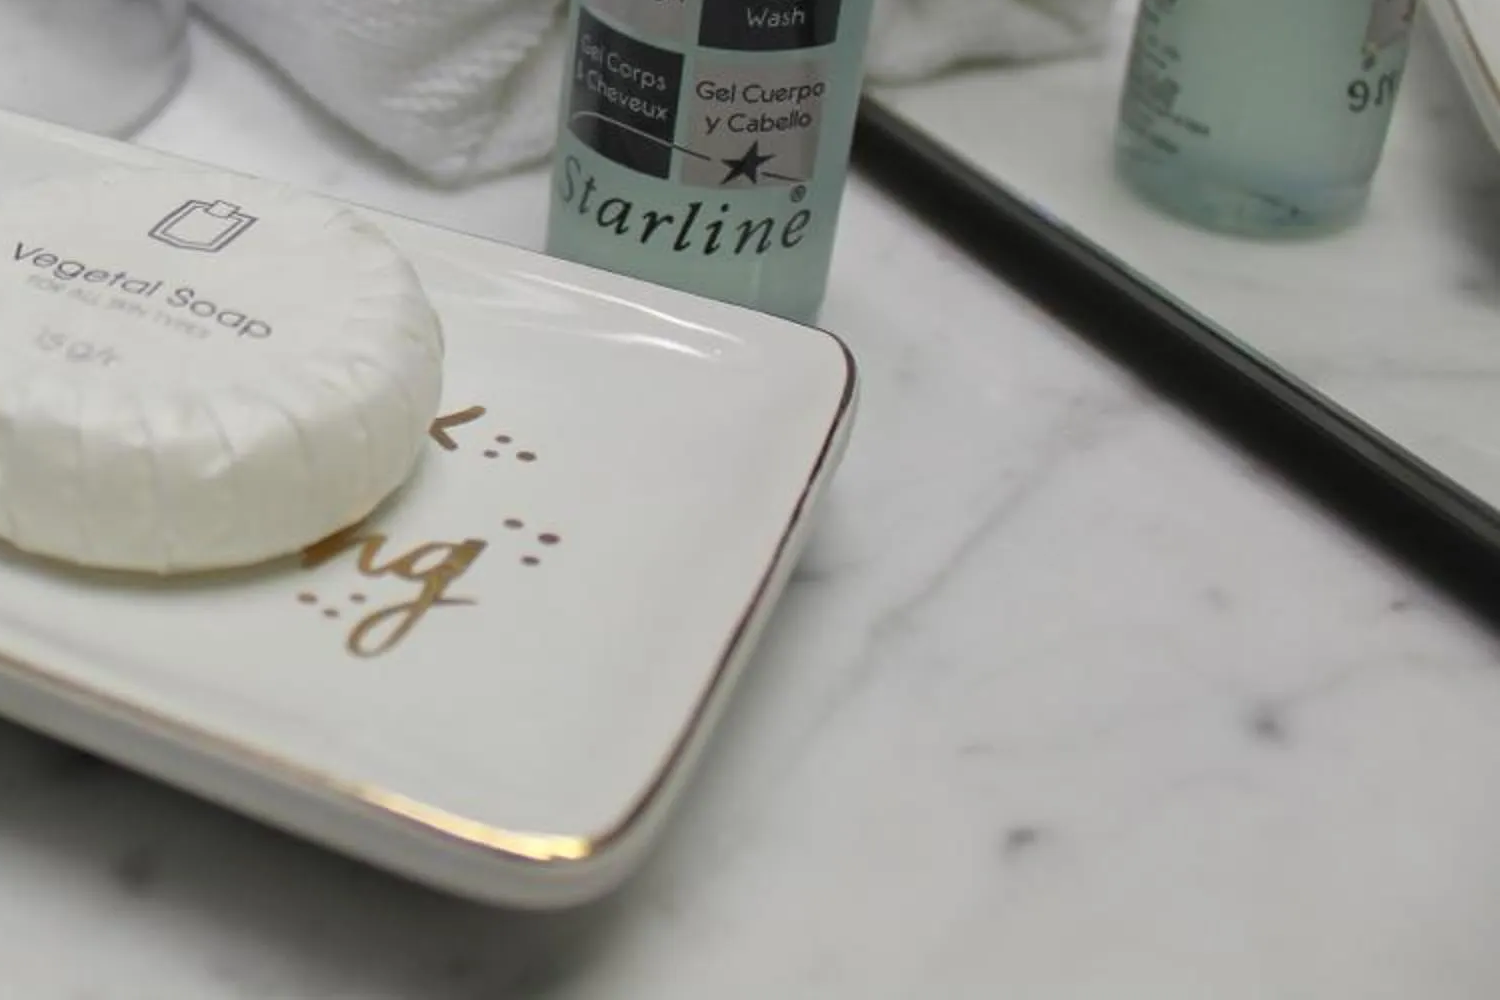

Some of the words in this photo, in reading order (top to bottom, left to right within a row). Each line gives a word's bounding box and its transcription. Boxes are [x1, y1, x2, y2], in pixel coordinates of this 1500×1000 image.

[746, 6, 806, 28] Wash
[606, 51, 667, 92] Corps
[585, 69, 669, 121] Cheveux
[694, 79, 738, 102] Gel
[741, 80, 827, 107] Cuerpo
[704, 114, 722, 135] y
[726, 108, 813, 135] Cabello
[11, 241, 164, 297] Vegetal
[165, 286, 273, 339] Soap
